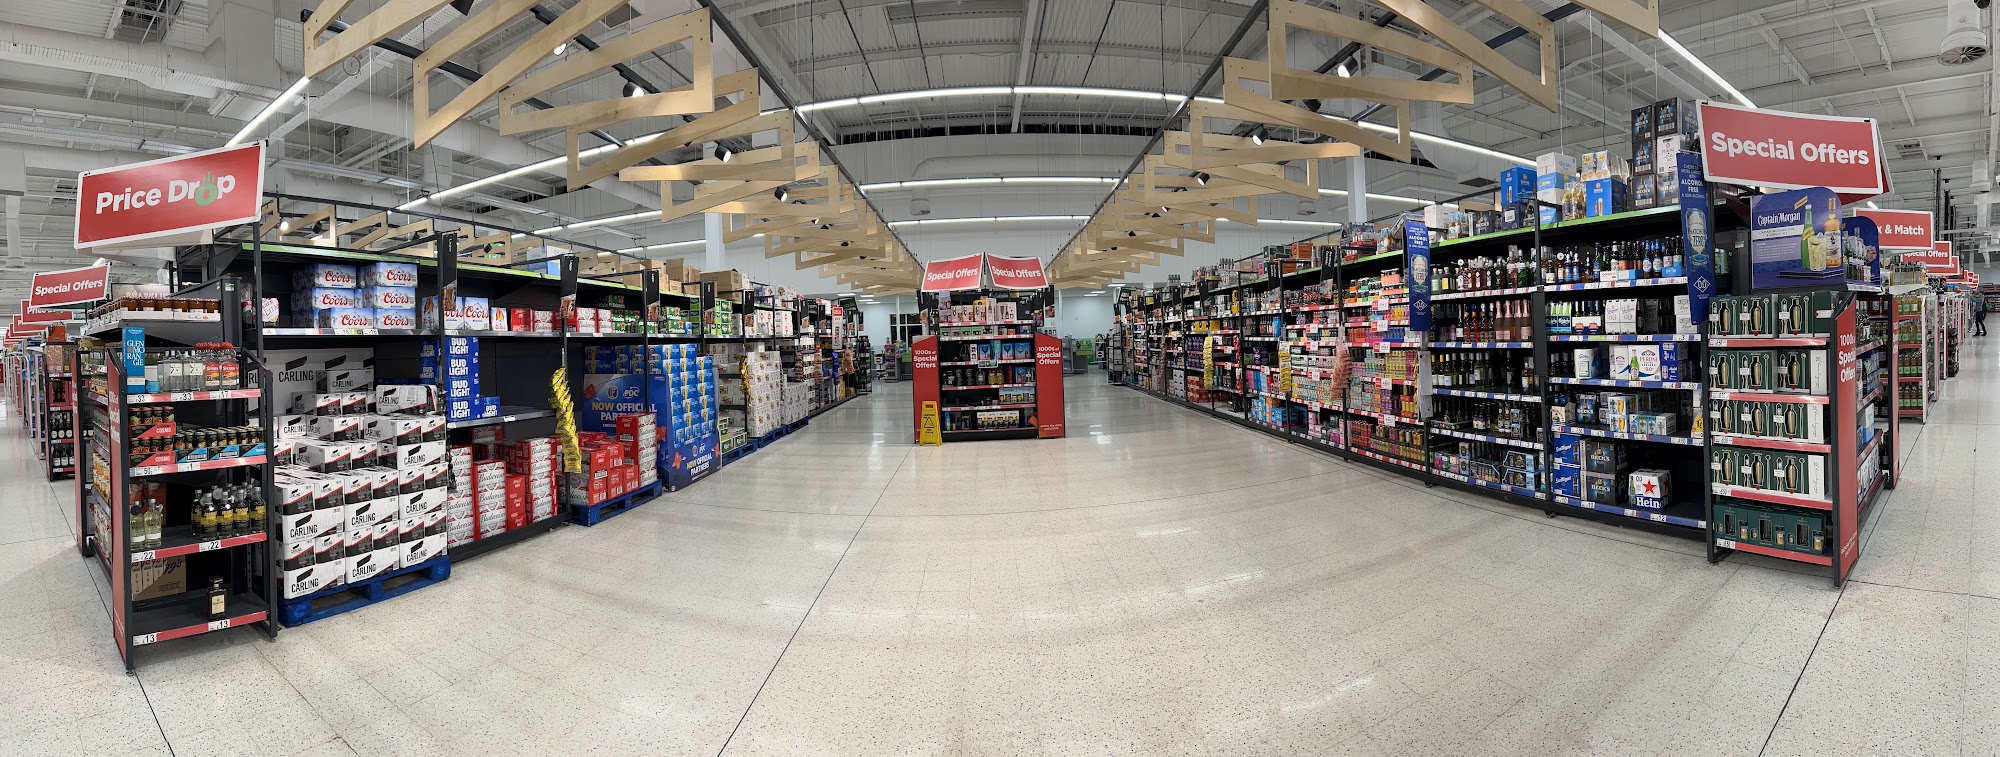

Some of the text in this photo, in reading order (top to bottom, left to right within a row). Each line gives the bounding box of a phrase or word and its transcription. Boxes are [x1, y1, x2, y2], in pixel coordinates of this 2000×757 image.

[1711, 131, 1870, 165] Special Offers
[1681, 179, 1704, 187] ALCOHOL
[95, 173, 236, 214] Price Drop
[1757, 211, 1801, 227] Captain Morgan
[1884, 224, 1892, 235] &
[1894, 225, 1924, 236] Match
[1928, 250, 1948, 258] Offers
[324, 271, 350, 283] Coors
[386, 269, 411, 281] Coors
[926, 267, 979, 282] Special Offers
[991, 265, 1041, 278] Special Offers
[34, 279, 103, 297] Special Offers
[322, 293, 348, 305] Coors
[383, 292, 409, 304] Coors
[465, 307, 489, 319] Coors
[341, 314, 367, 326] Coors
[383, 314, 409, 326] Coors
[450, 337, 467, 346] BUD
[449, 346, 469, 356] LIGHT
[1036, 351, 1061, 360] Special
[450, 357, 467, 367] BUD
[913, 355, 937, 363] Special
[1039, 358, 1060, 366] Offers
[278, 370, 314, 383] CARLING
[449, 368, 469, 378] LIGHT
[332, 380, 354, 388] CARLING
[451, 379, 468, 389] BUD
[450, 389, 470, 398] LIGHT
[624, 389, 640, 397] PDC
[452, 400, 469, 410] BUD
[592, 402, 614, 411] NOW
[450, 409, 470, 419] LIGHT
[283, 425, 307, 434] CARLING
[403, 454, 426, 465] CARLING
[686, 459, 697, 468] NOW
[1591, 454, 1610, 462] BECK'S
[1591, 484, 1611, 492] BECK'S
[405, 502, 428, 514] CARLING
[351, 513, 376, 526] CARLING
[289, 524, 318, 538] CARLING
[406, 549, 428, 562] CARLING
[352, 563, 377, 577] CARLING
[291, 577, 319, 593] CARLING
